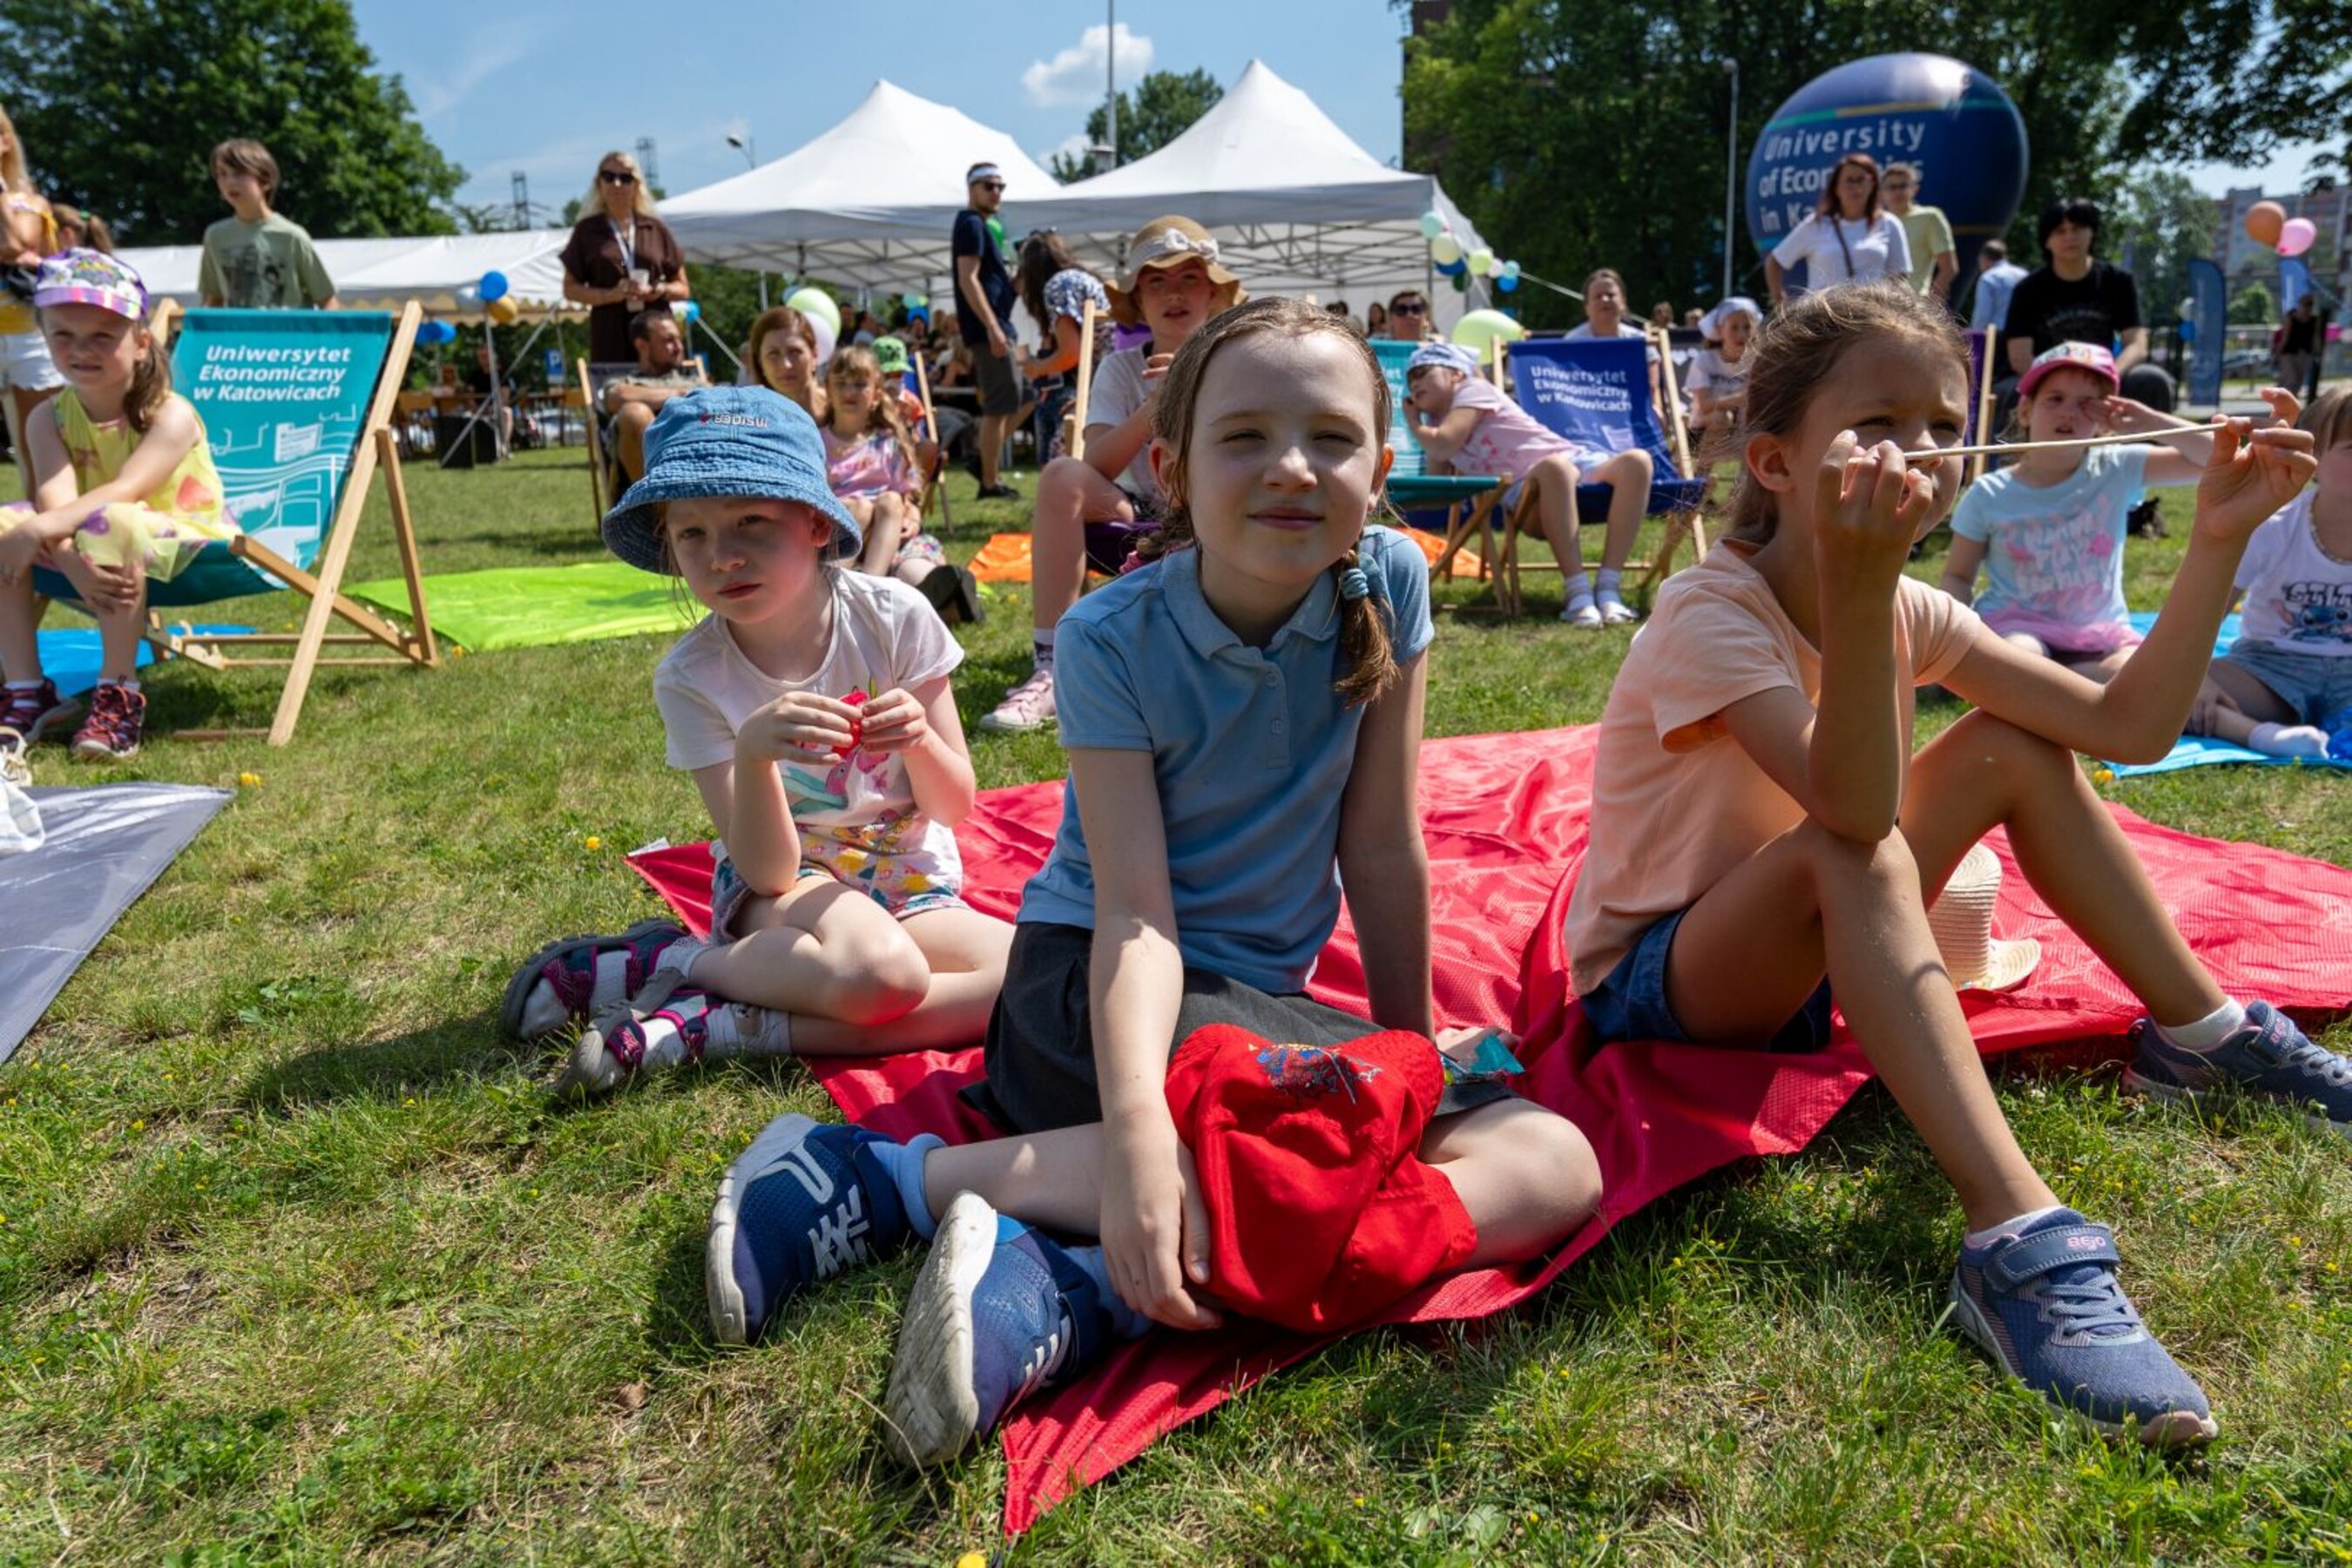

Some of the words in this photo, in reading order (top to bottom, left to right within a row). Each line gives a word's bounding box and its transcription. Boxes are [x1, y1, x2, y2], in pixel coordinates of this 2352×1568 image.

[1763, 119, 1926, 162] University
[1759, 166, 1780, 199] of
[1760, 206, 1781, 233] in
[205, 345, 351, 366] Uniwersytet
[199, 364, 348, 385] Ekonomiczny
[1531, 365, 1626, 385] Uniwersytet
[193, 387, 214, 401] w
[217, 383, 341, 402] Katowicach
[1536, 393, 1552, 403] w
